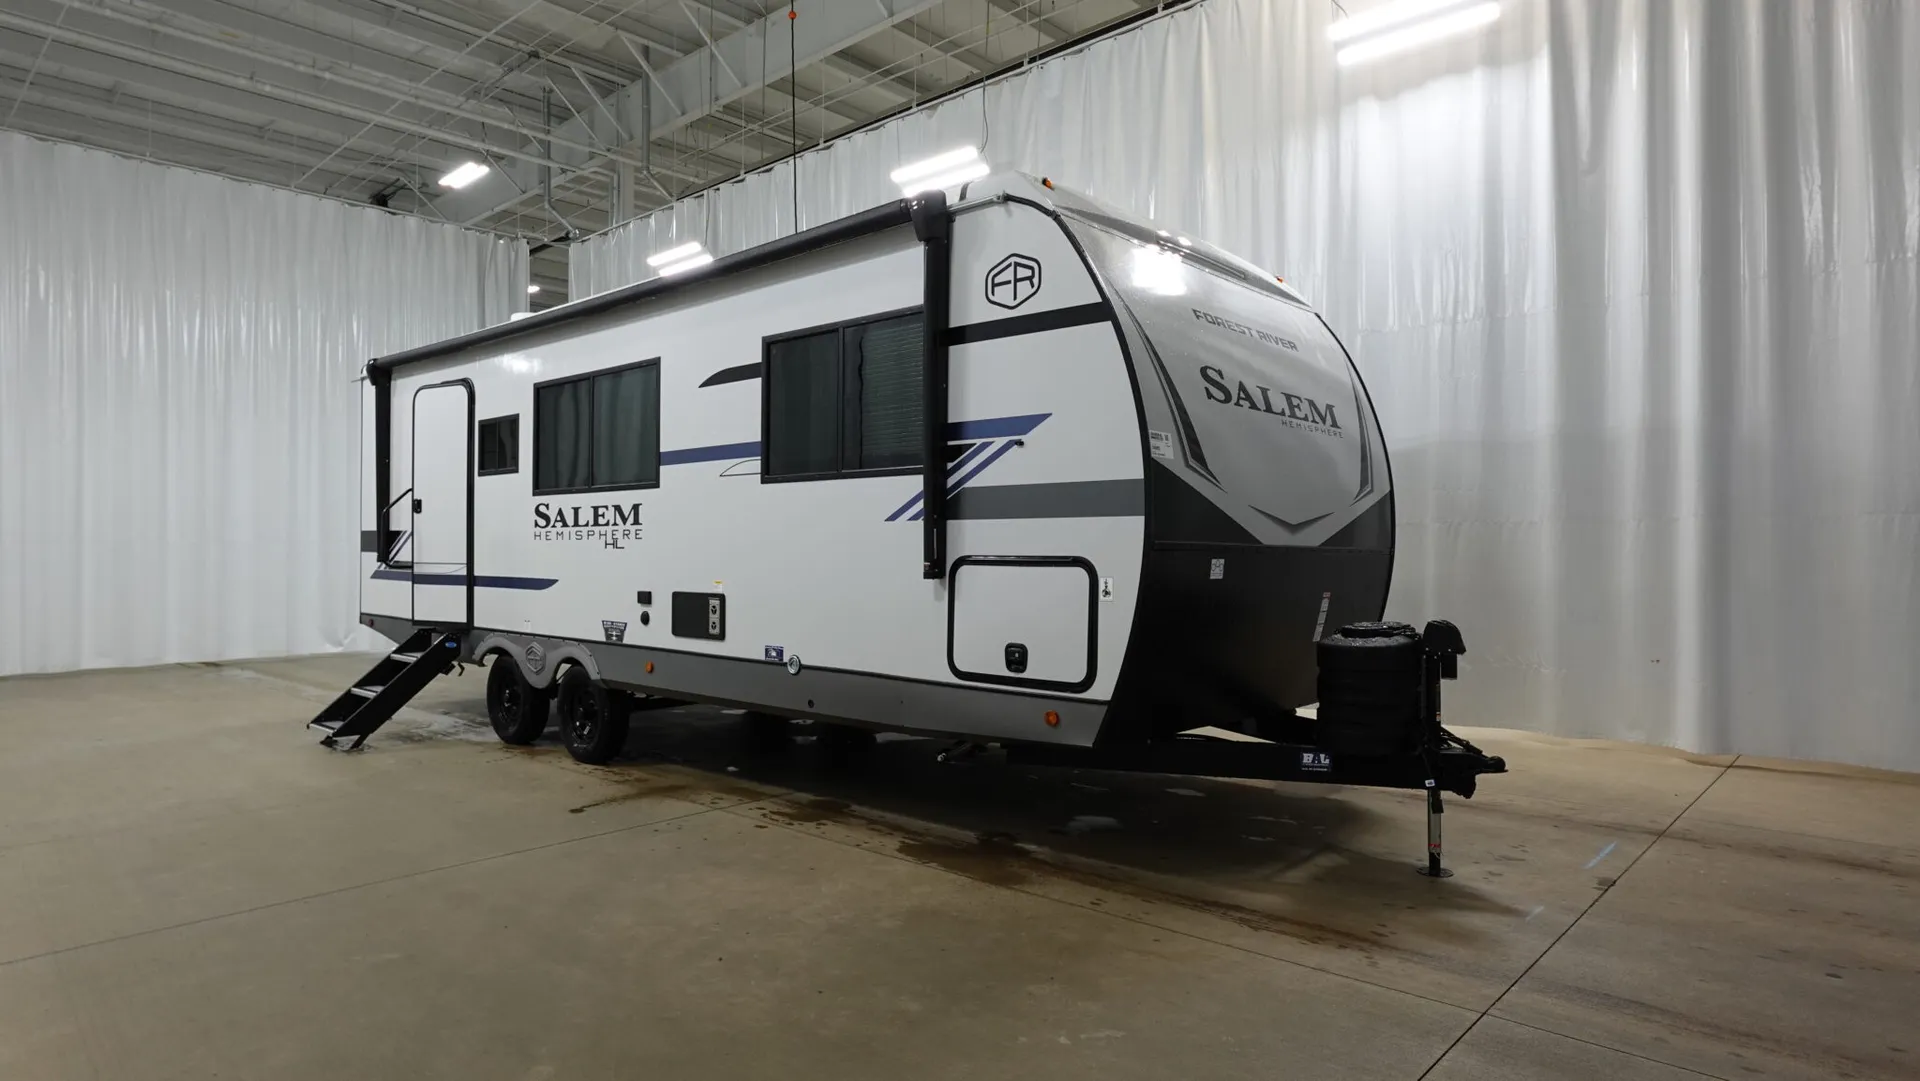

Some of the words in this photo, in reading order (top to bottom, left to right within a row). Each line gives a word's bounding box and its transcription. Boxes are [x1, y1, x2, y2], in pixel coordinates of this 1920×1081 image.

[1191, 308, 1254, 338] FOREST
[1256, 329, 1299, 352] RIVER
[1200, 365, 1341, 430] SALEM
[1281, 419, 1343, 439] HEMISPHERE
[534, 503, 643, 529] SALEM
[534, 529, 643, 540] HEMISPHERE
[605, 539, 625, 549] HL
